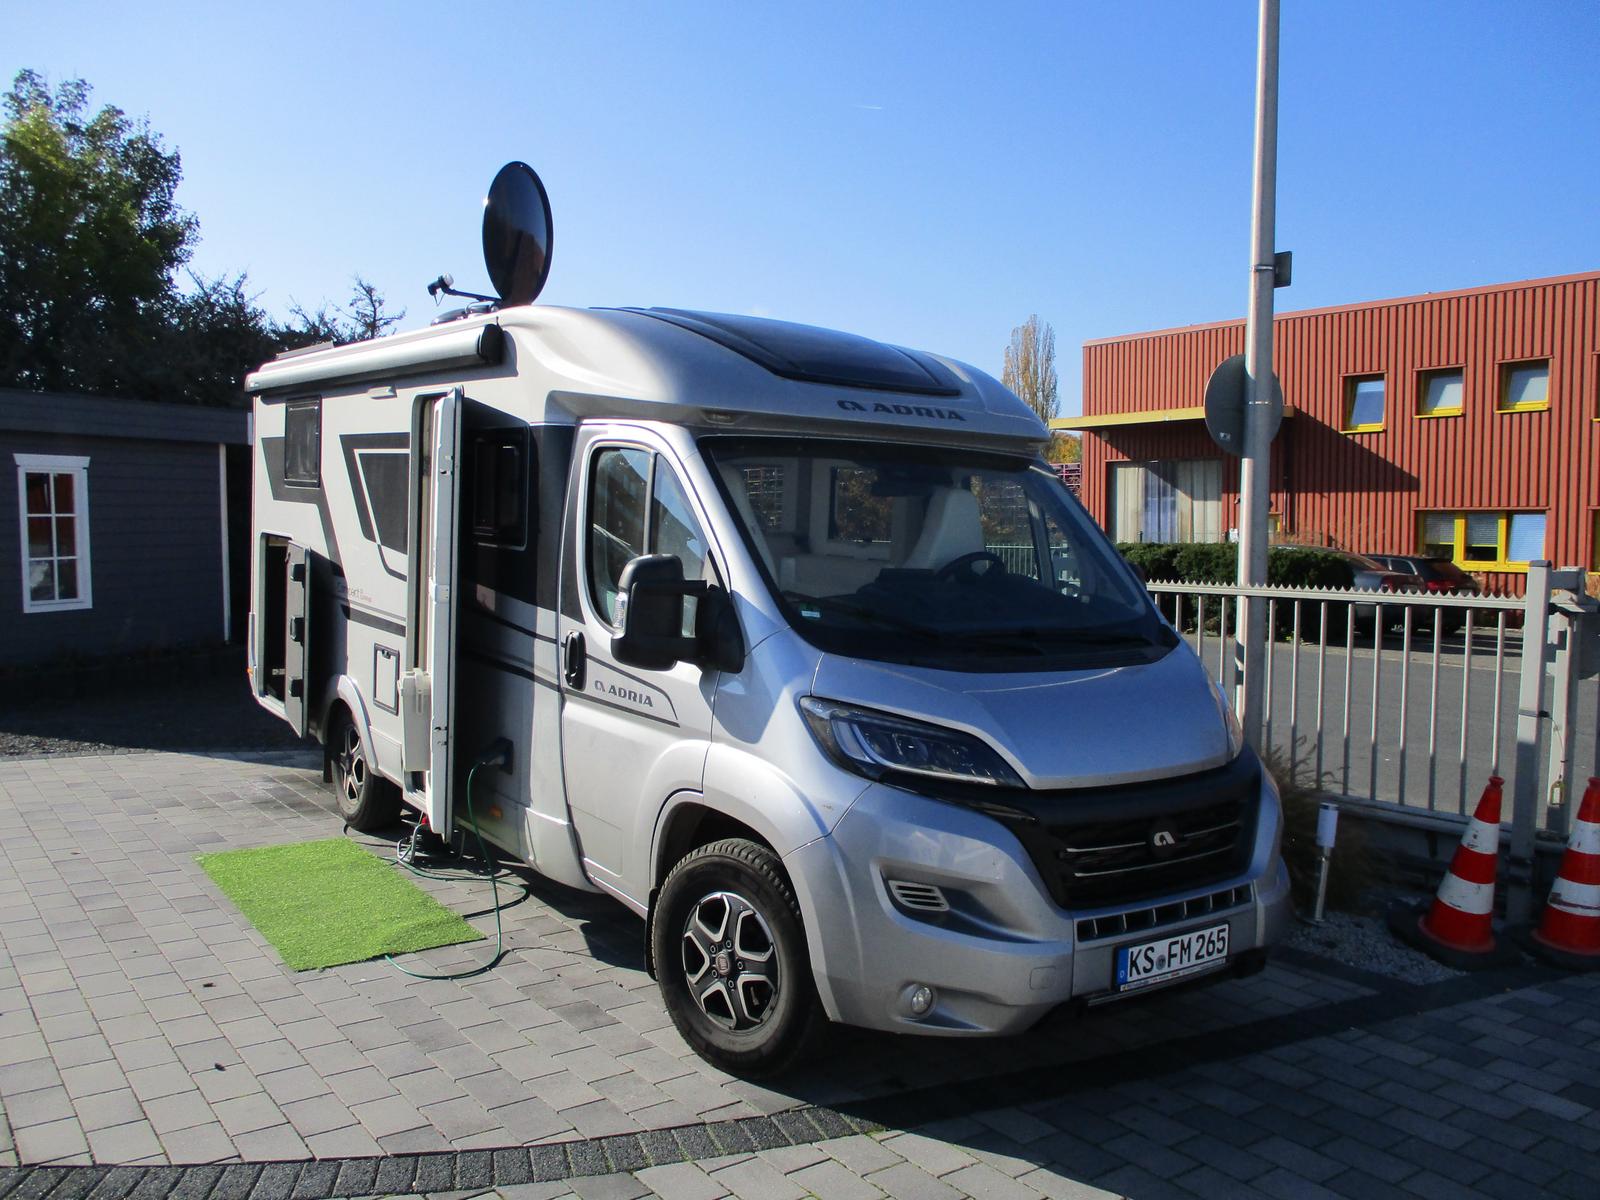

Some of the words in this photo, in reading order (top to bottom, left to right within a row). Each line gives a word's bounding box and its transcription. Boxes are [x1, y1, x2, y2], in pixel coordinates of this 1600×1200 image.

[873, 402, 967, 421] ADRIA
[608, 684, 654, 707] ADRIA
[1129, 946, 1155, 978] KS
